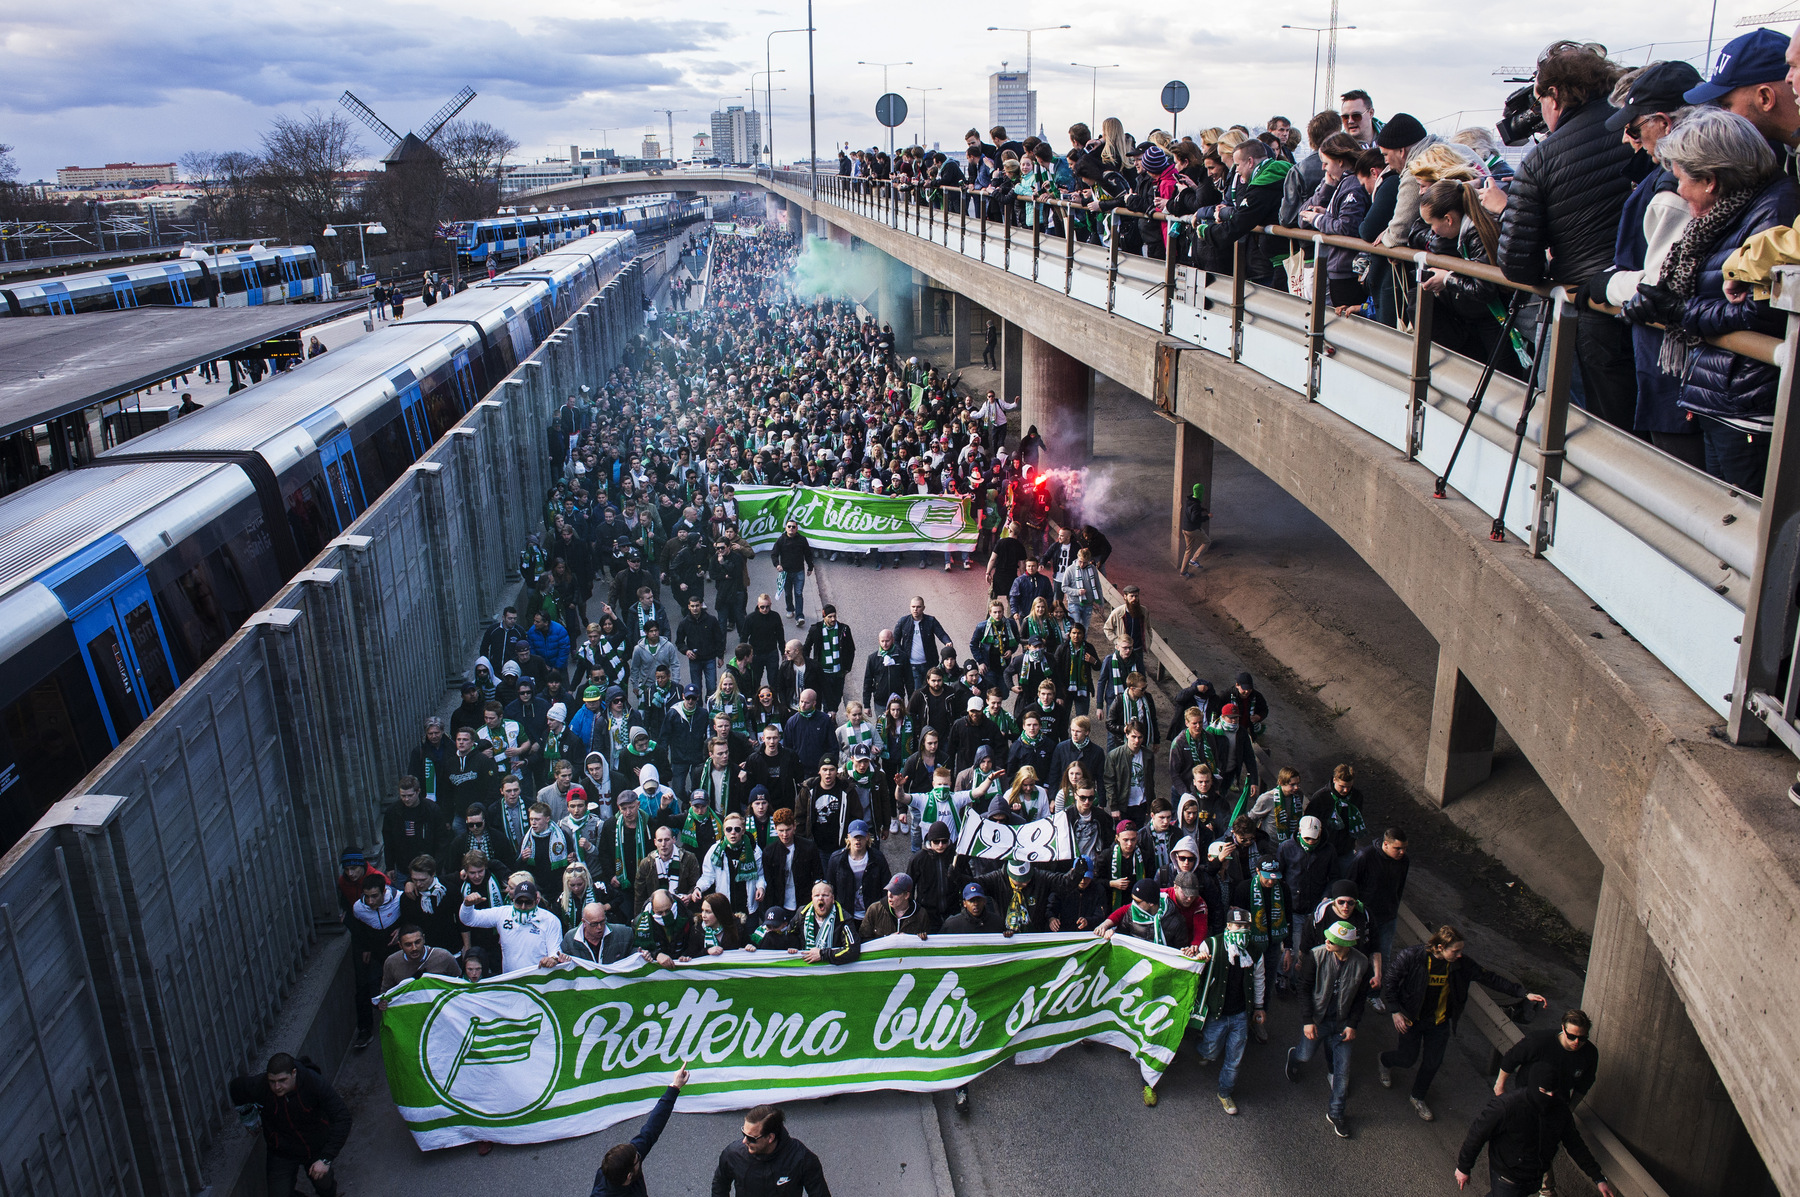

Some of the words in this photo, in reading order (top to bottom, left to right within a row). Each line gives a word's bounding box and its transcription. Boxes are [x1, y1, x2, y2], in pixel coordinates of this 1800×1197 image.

[823, 498, 904, 531] blåser
[955, 806, 1077, 863] 1981
[767, 912, 775, 920] NY
[572, 987, 849, 1079] Rötterna
[873, 970, 985, 1051] blir
[1005, 956, 1178, 1037] starka
